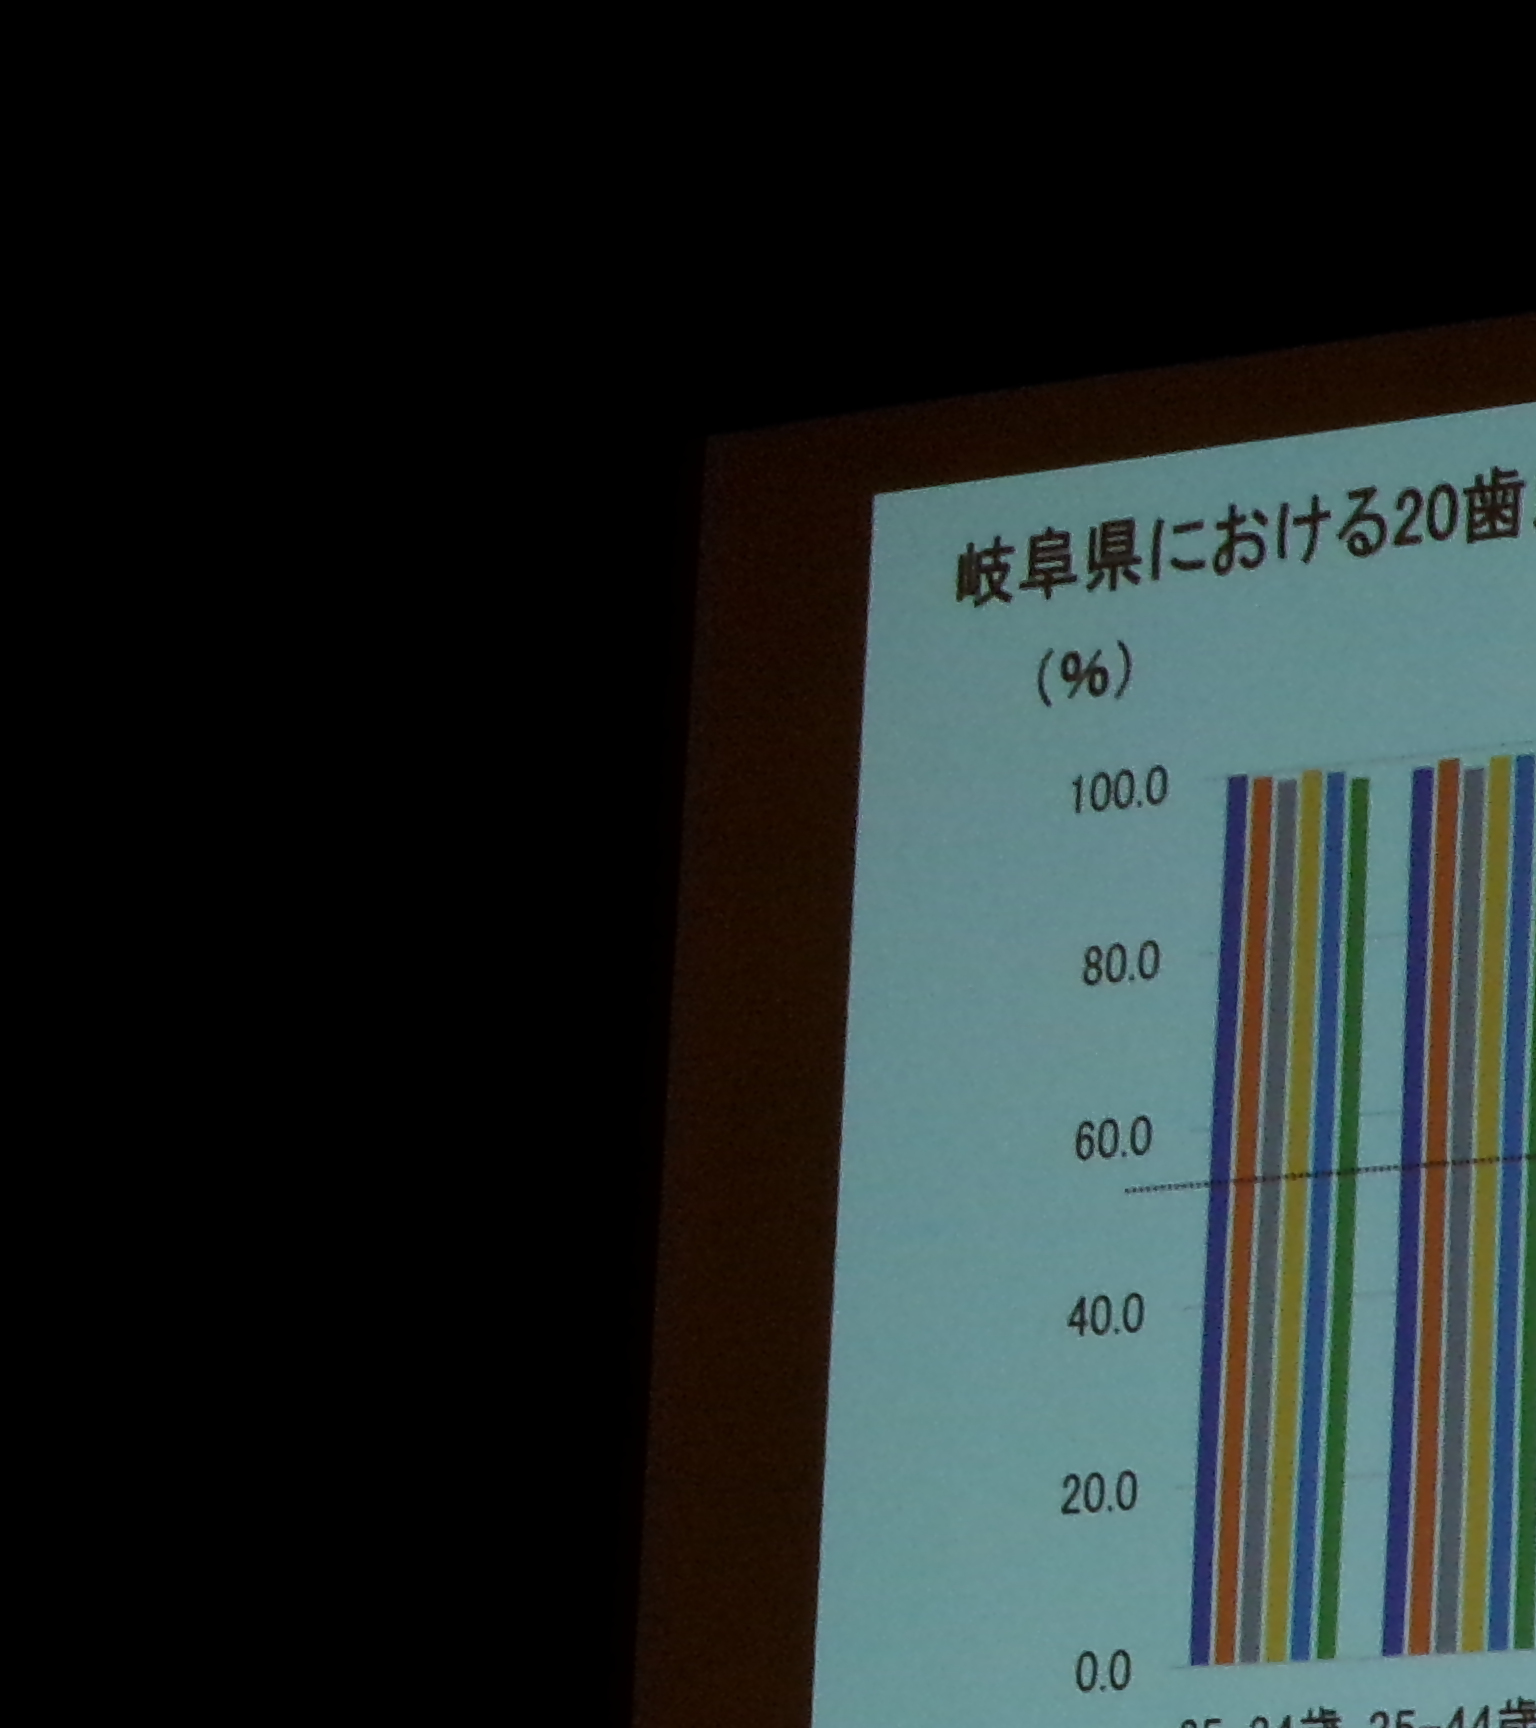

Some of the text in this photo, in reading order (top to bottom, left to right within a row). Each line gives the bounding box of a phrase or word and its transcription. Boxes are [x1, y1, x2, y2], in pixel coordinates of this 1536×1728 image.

[1072, 765, 1168, 814] 100.0
[1082, 940, 1160, 986] 80.0
[1075, 1115, 1152, 1161] 60.0
[1067, 1292, 1144, 1336] 40.0
[1061, 1470, 1137, 1515] 20.0
[1075, 1649, 1131, 1693] 0.0
